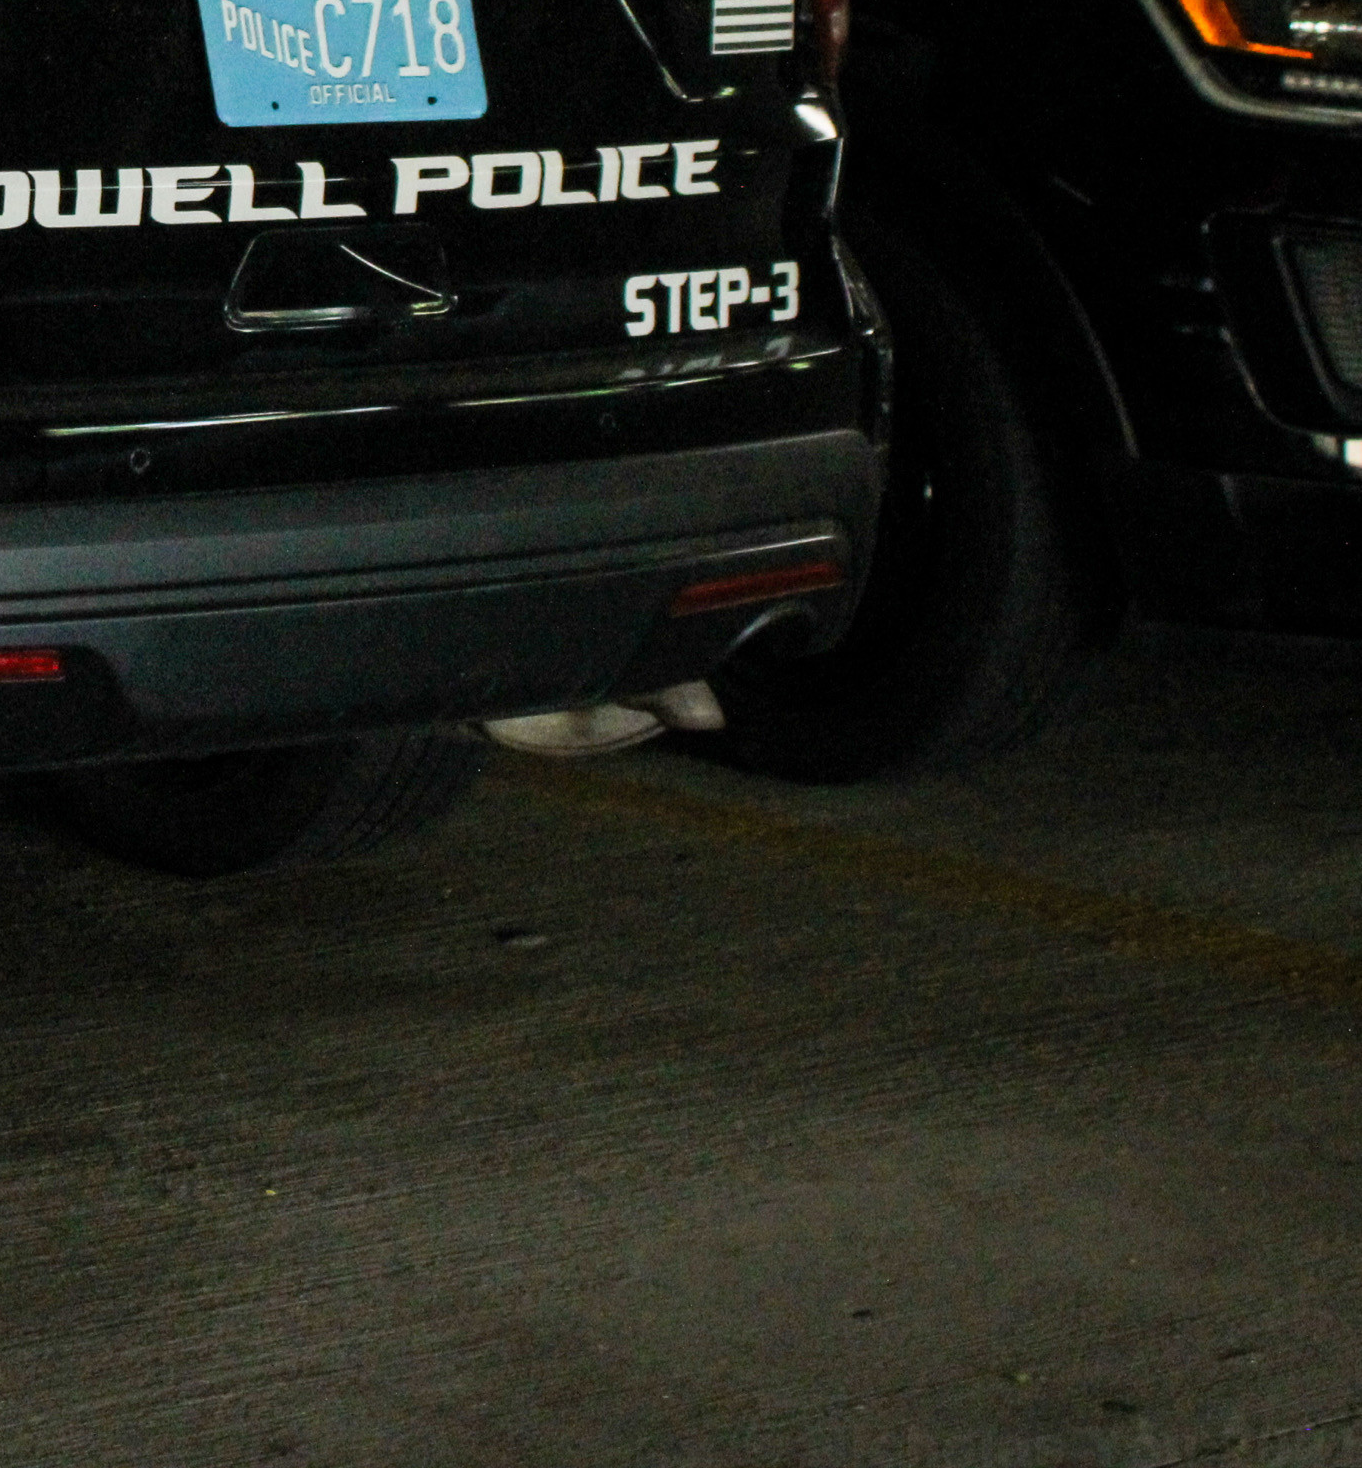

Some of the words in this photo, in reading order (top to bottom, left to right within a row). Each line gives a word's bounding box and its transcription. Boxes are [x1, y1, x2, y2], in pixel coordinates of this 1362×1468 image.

[309, 81, 397, 106] OFFICIAL
[391, 138, 721, 215] POLICE
[624, 261, 801, 338] STEP-3
